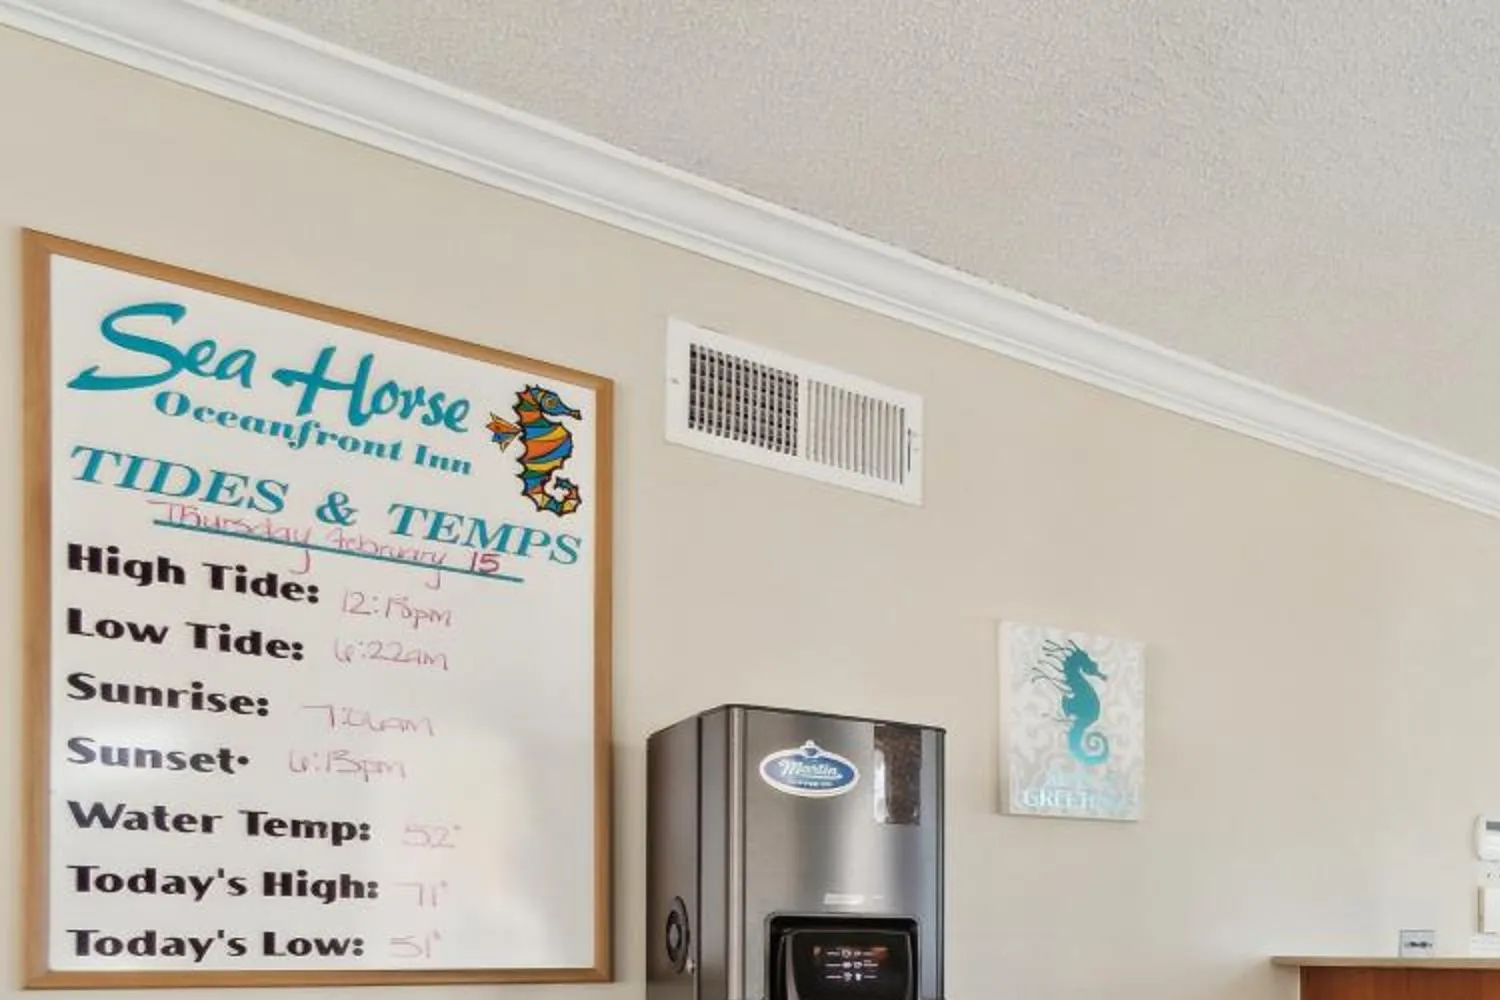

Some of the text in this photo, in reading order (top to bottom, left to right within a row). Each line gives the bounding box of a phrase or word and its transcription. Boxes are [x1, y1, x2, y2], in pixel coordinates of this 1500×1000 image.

[66, 302, 472, 433] Sea Horse
[154, 391, 473, 476] Oceanfront Inn
[70, 445, 582, 566] TIDES & TEMPS
[66, 543, 320, 605] High Tide:
[469, 551, 501, 575] 15
[66, 608, 305, 662] Low Tide:
[66, 672, 270, 718] Sunrise:
[66, 801, 371, 846] Water Temp:
[66, 864, 379, 904] Today's High:
[66, 928, 364, 962] Today's Low:
